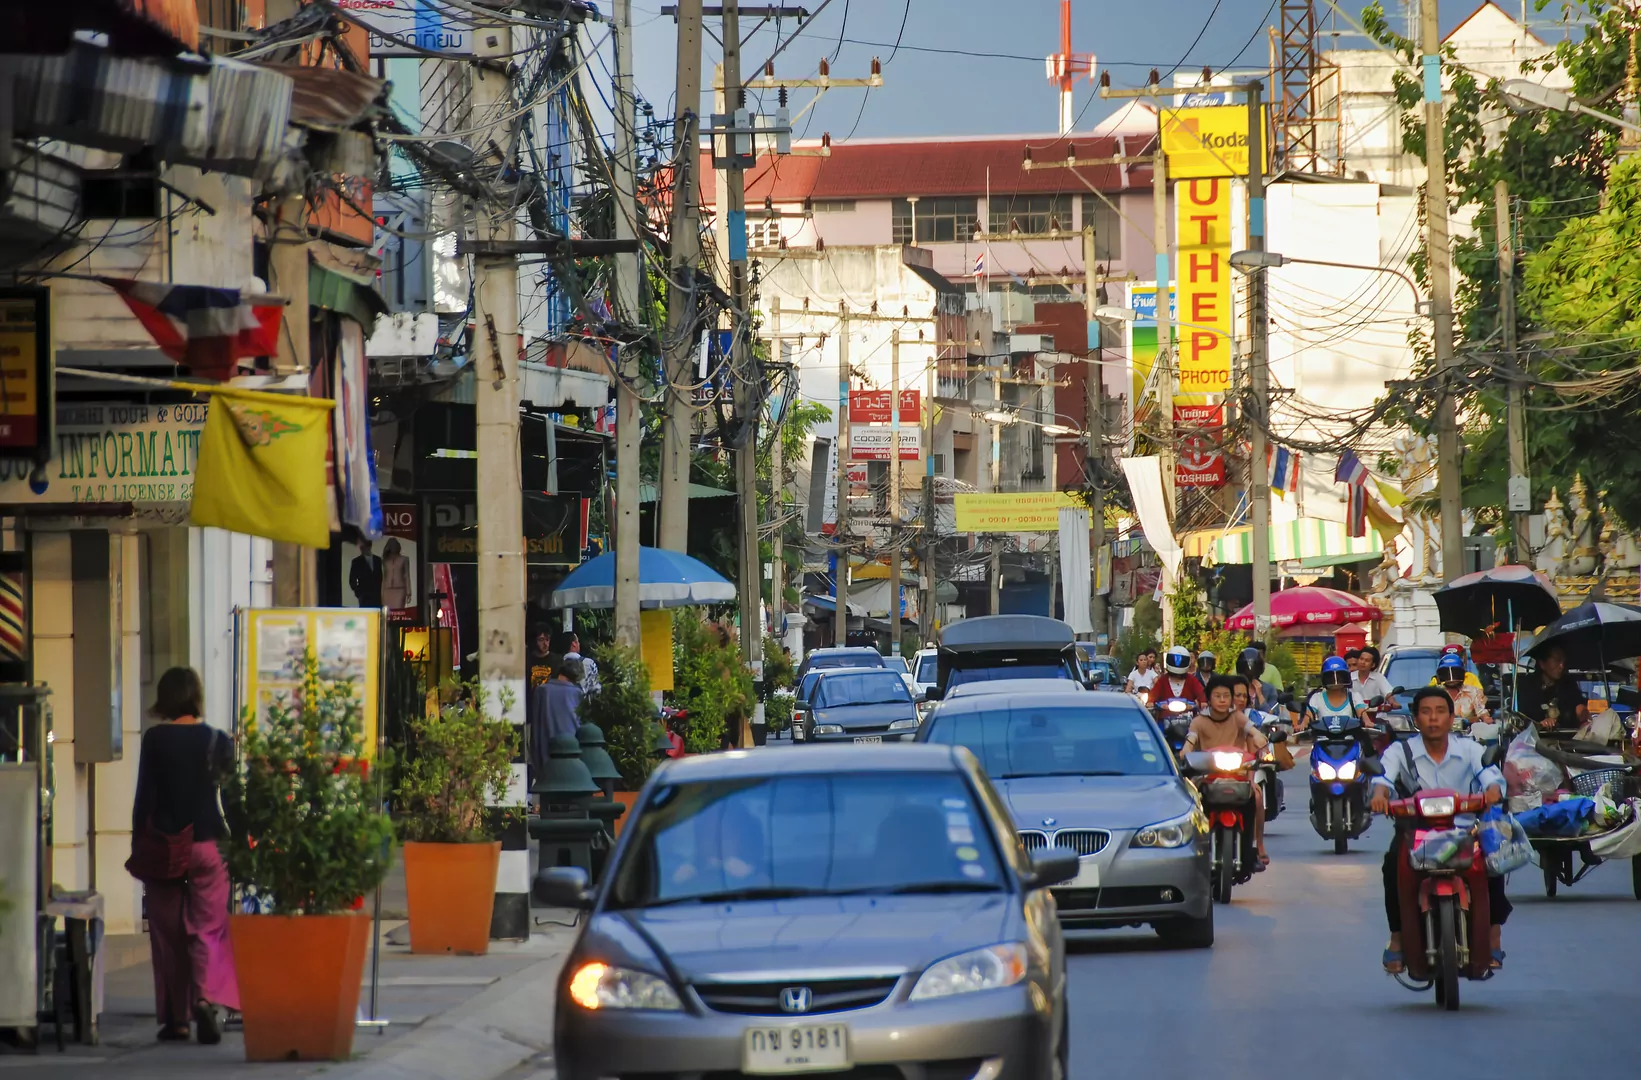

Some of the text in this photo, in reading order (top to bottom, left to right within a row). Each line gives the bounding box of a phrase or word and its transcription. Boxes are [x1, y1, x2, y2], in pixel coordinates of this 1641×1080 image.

[1201, 132, 1249, 149] Koda
[1222, 151, 1249, 164] FIL
[1181, 370, 1229, 384] PHOTO
[109, 406, 149, 424] TOUR
[157, 406, 168, 422] &
[848, 472, 866, 481] 3M
[1176, 473, 1219, 483] TOSHIBA
[113, 484, 175, 500] LICENSE
[386, 512, 412, 526] NO
[791, 1027, 840, 1049] 9181
